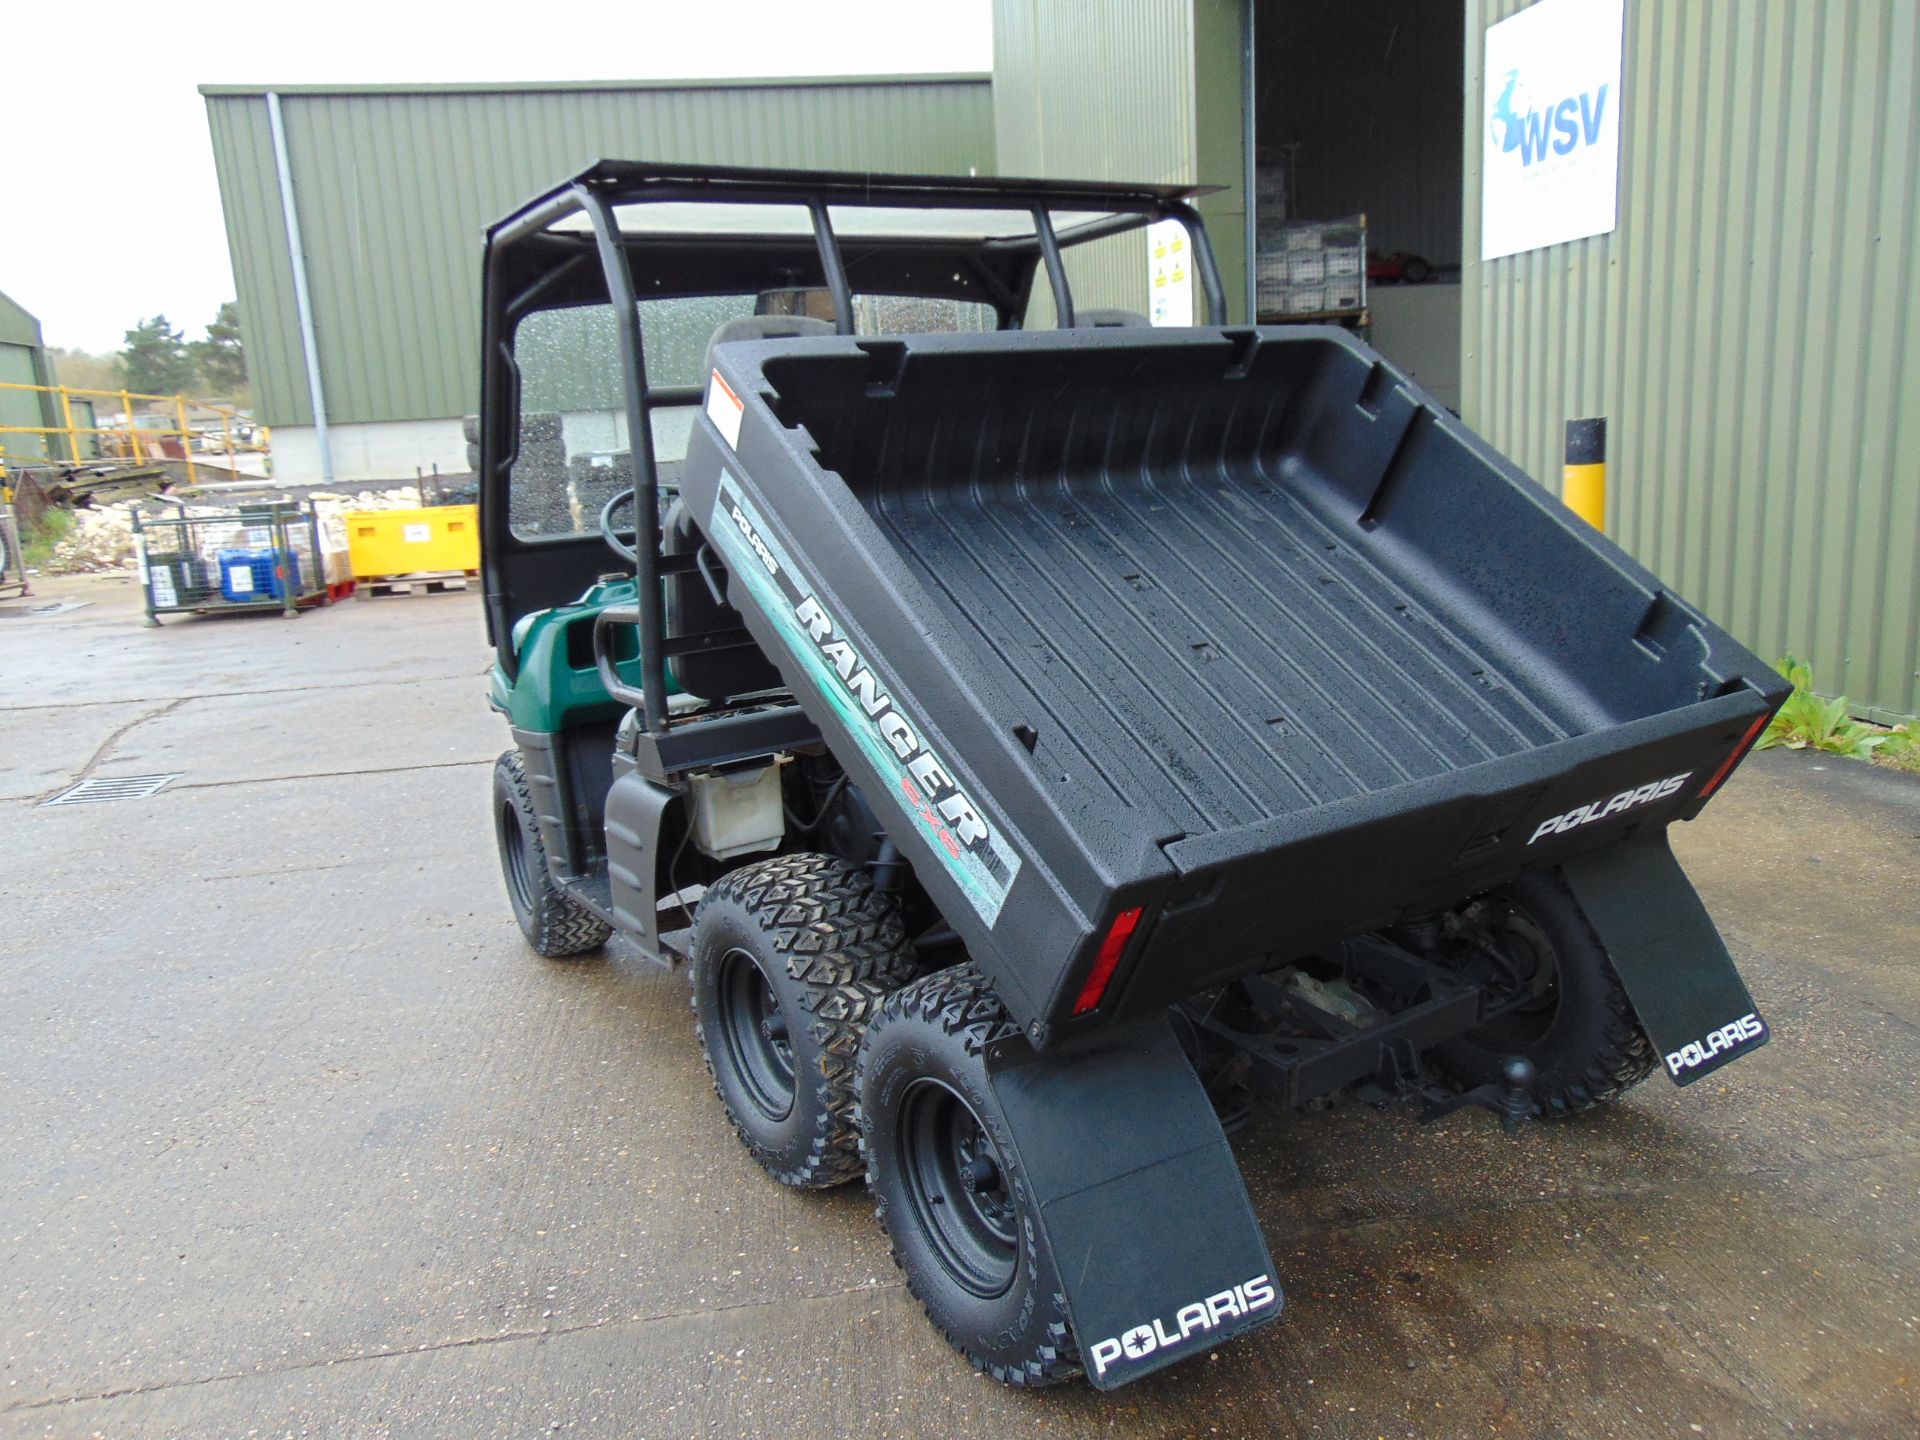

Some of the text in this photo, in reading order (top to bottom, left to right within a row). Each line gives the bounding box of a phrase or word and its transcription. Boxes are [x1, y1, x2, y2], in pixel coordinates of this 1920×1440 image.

[1519, 84, 1608, 167] WSV
[732, 505, 780, 575] POLARIS
[795, 595, 989, 846] RANGER
[1526, 772, 1694, 846] POLARIS
[1664, 1013, 1763, 1076] POLARIS
[1090, 1275, 1275, 1375] POLARIS
